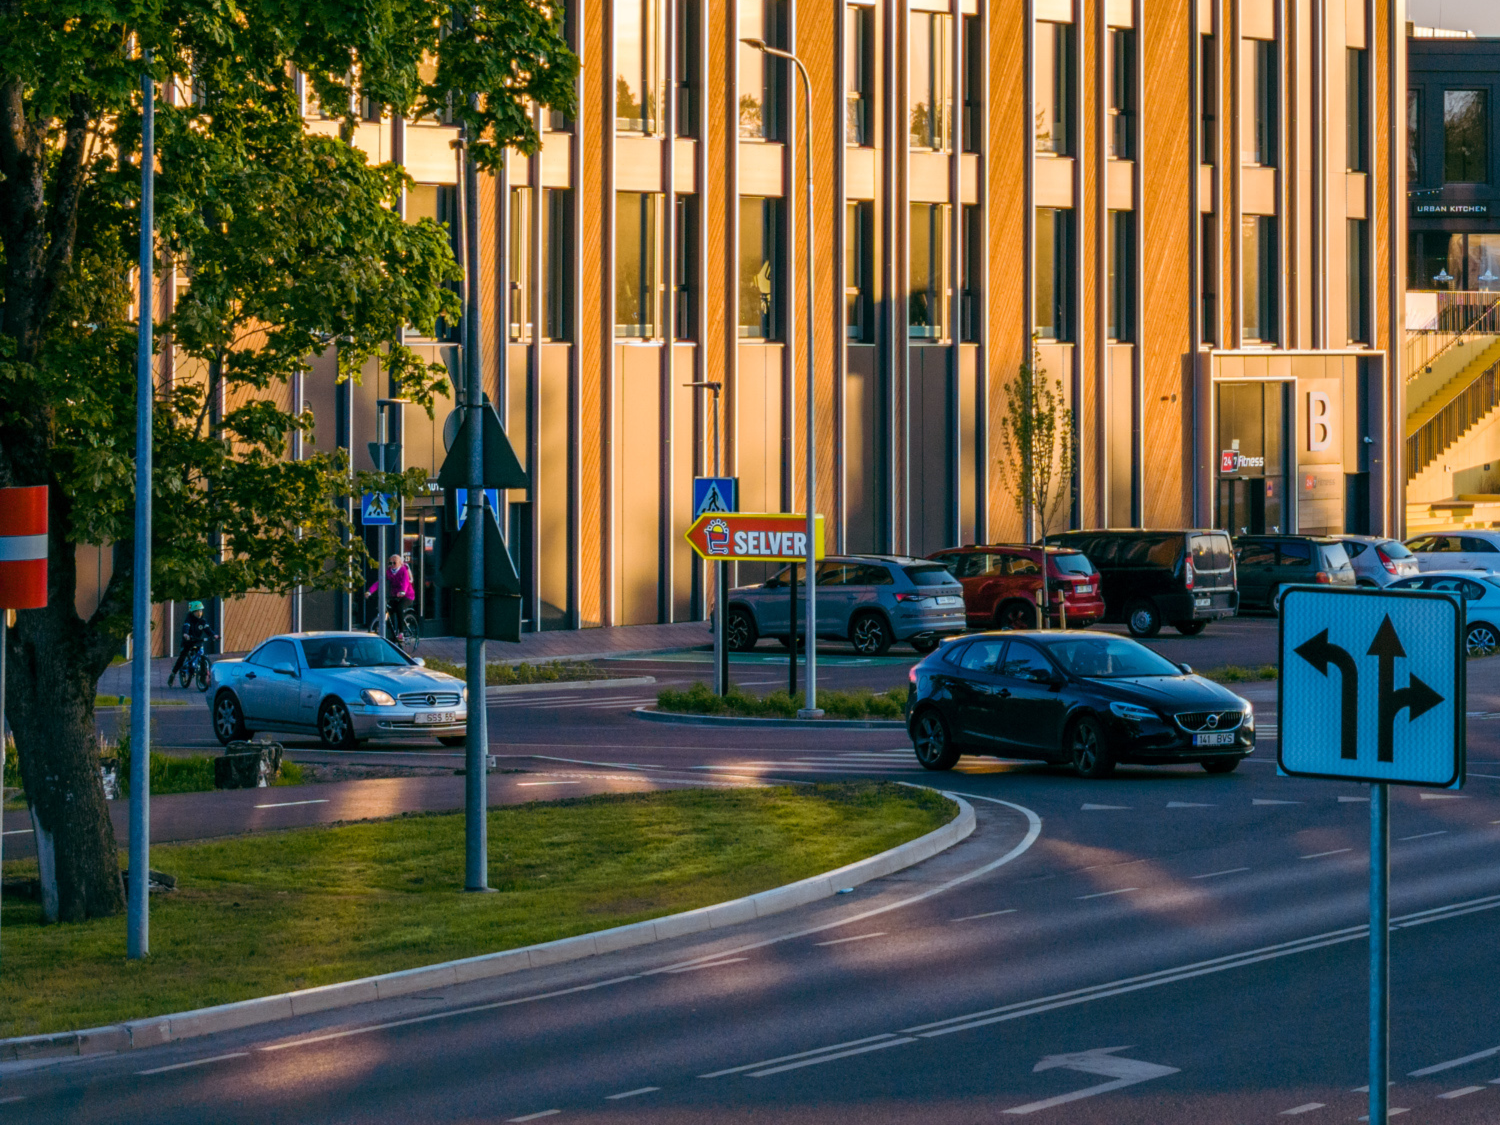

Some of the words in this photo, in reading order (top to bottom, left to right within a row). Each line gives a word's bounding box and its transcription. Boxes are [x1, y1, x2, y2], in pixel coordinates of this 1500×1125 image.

[1307, 391, 1333, 452] B
[1223, 456, 1232, 466] 24
[734, 530, 807, 556] SELVER
[1200, 735, 1211, 743] 141
[1216, 734, 1233, 743] BVS
